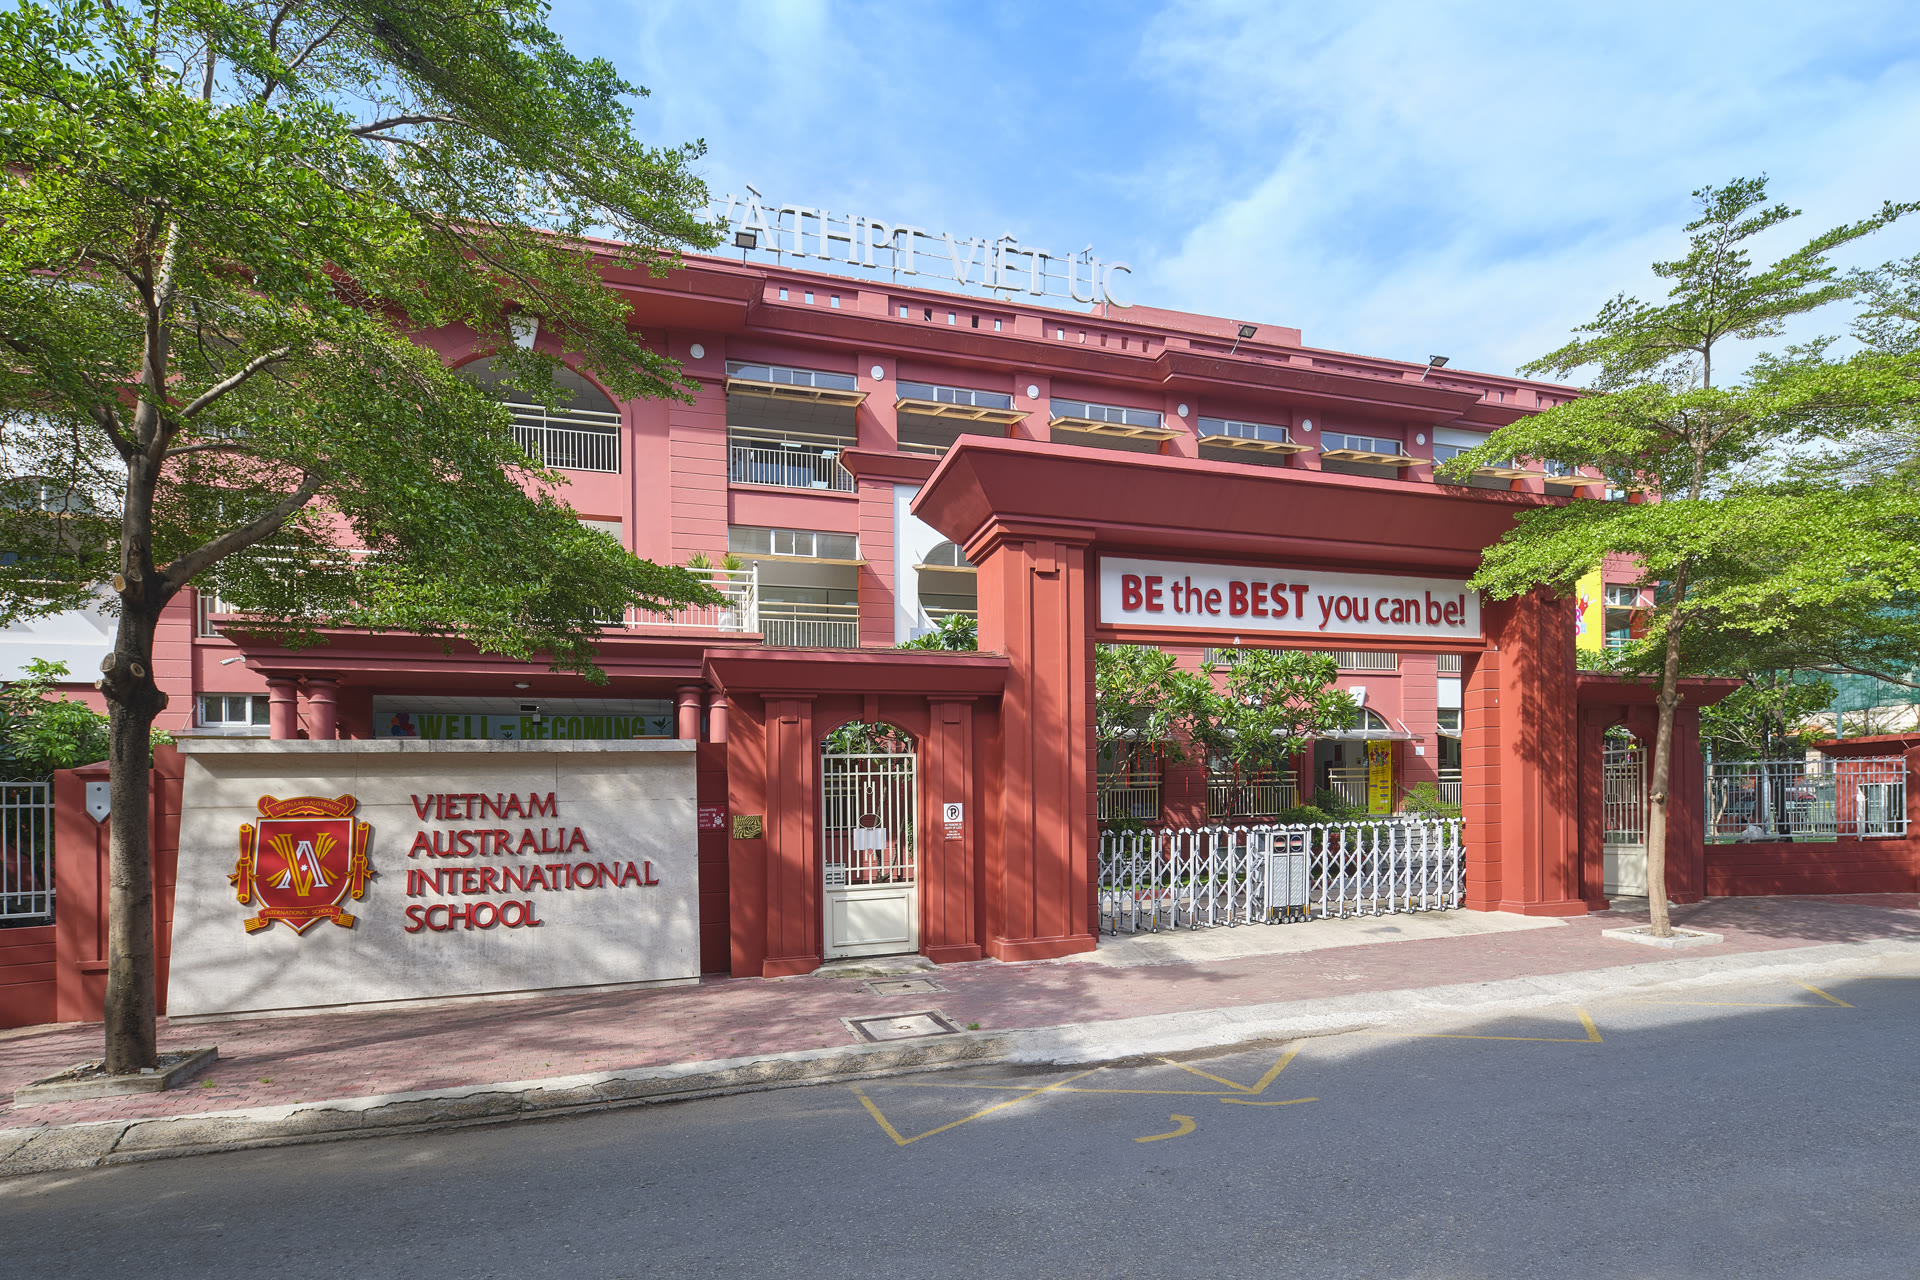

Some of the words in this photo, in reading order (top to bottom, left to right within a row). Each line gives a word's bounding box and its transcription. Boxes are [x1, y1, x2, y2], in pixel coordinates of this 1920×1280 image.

[780, 203, 927, 275] THPT
[943, 231, 1050, 302] VIỆT
[1067, 243, 1134, 309] ÚC
[1121, 575, 1164, 613] BE
[1171, 576, 1222, 614] the
[1229, 581, 1310, 618] BEST
[1317, 594, 1369, 630] you
[1375, 595, 1421, 624] can
[1425, 590, 1466, 625] be!
[275, 801, 305, 811] VIETNAM
[309, 801, 340, 811] AUSTRALIA
[410, 791, 558, 821] VIETNAM
[407, 826, 590, 858] AUSTRALIA
[406, 861, 659, 896] INTERNATIONAL
[404, 900, 542, 932] SCHOOL
